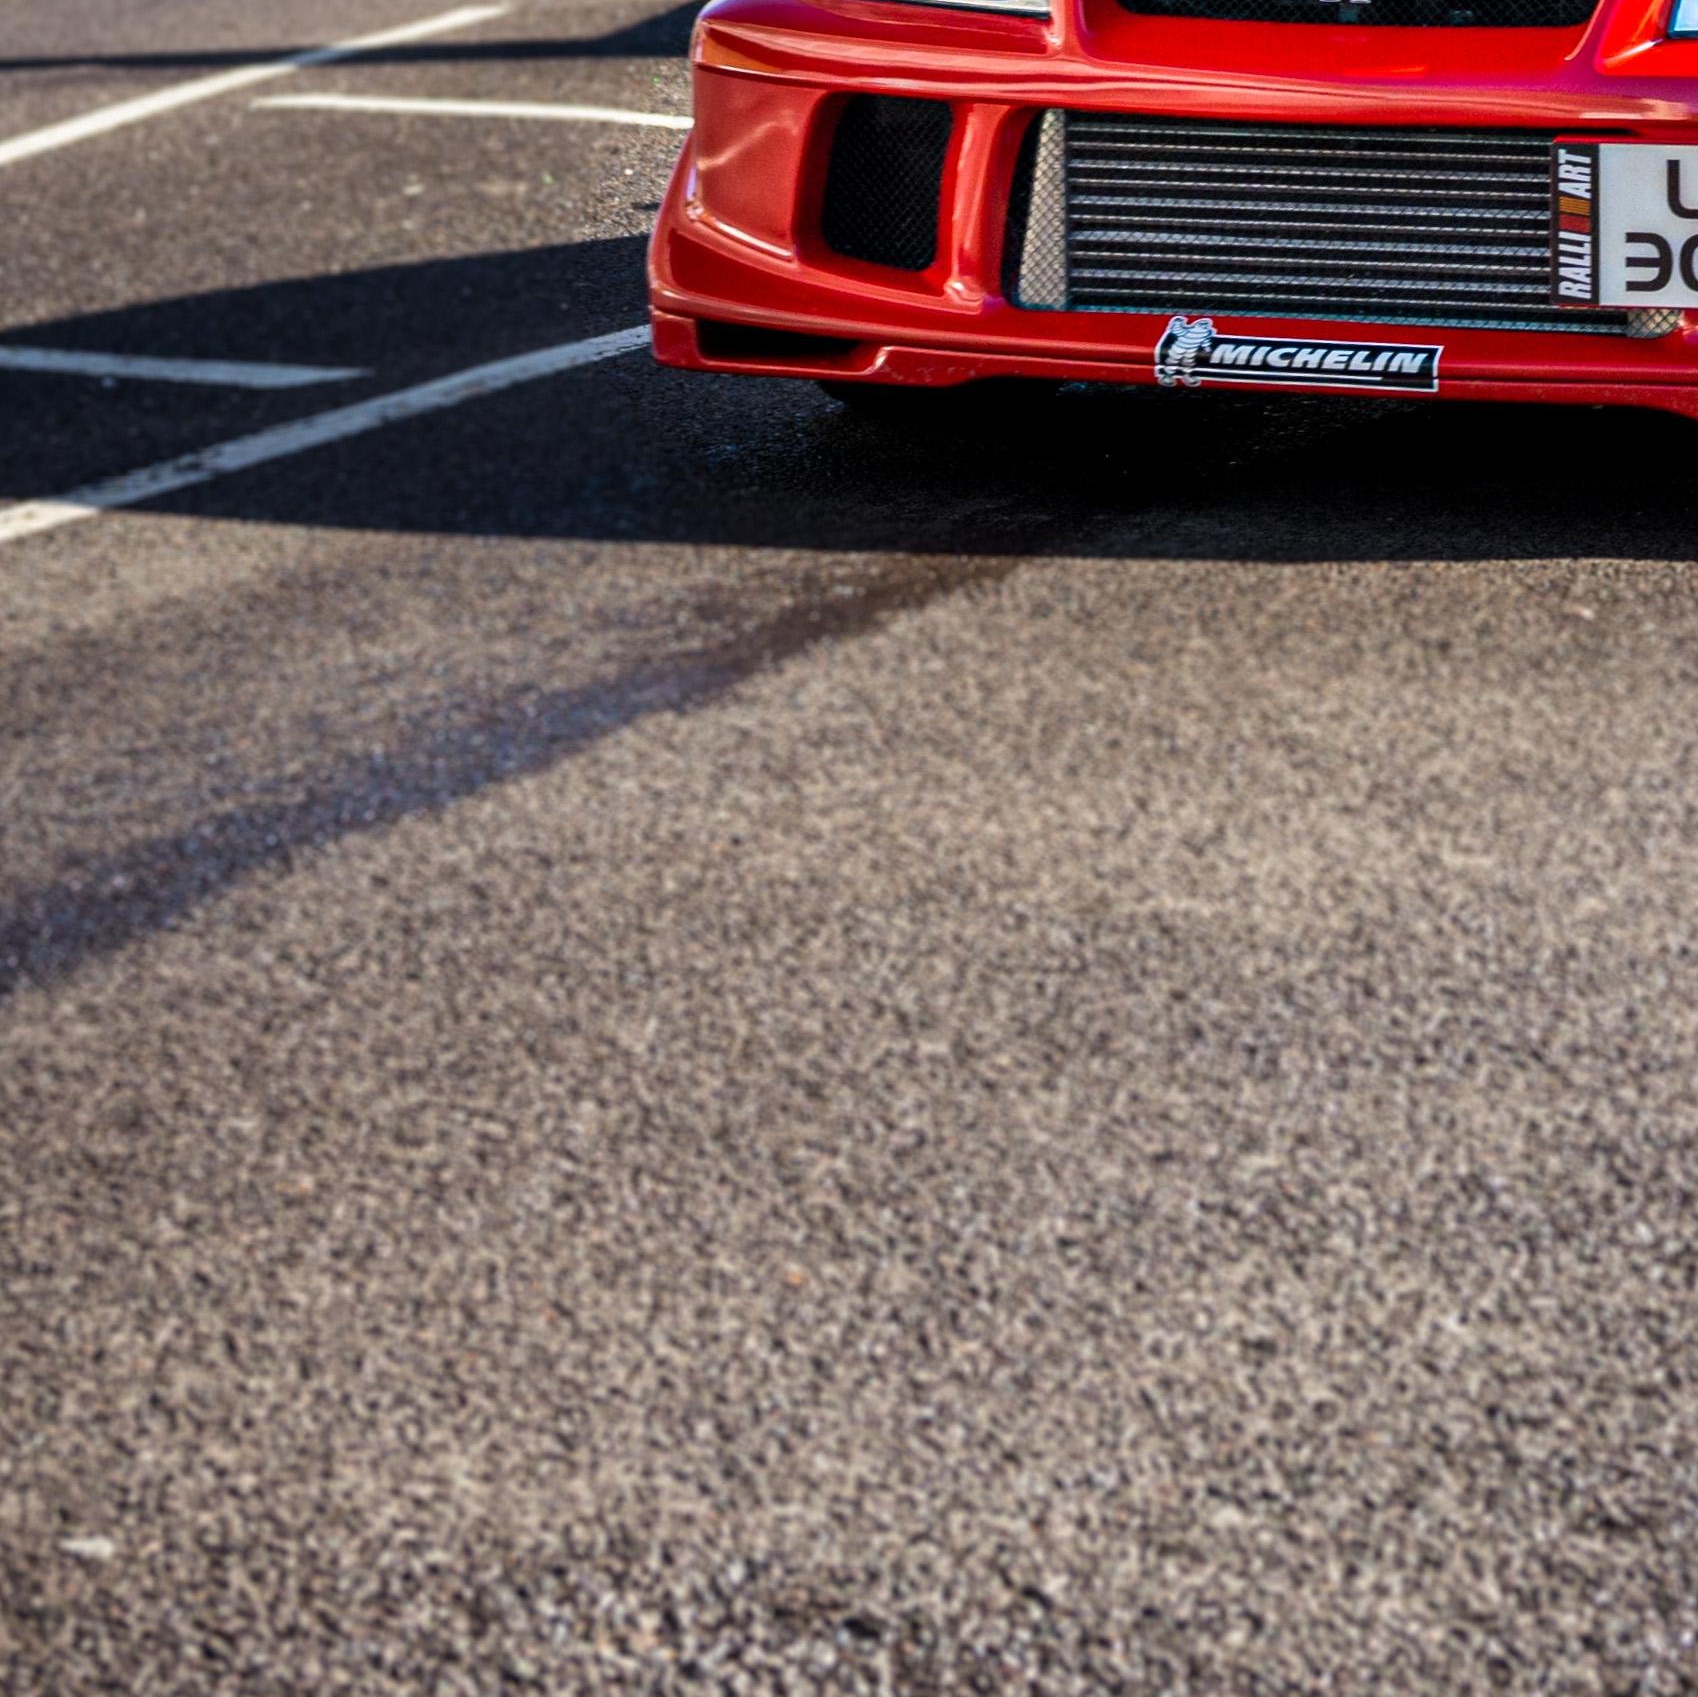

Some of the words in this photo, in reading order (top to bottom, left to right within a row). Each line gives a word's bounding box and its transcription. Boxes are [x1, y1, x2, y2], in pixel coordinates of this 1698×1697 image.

[1558, 149, 1592, 199] ART
[1558, 231, 1592, 299] RALLI
[1208, 342, 1430, 374] MICHELIN
